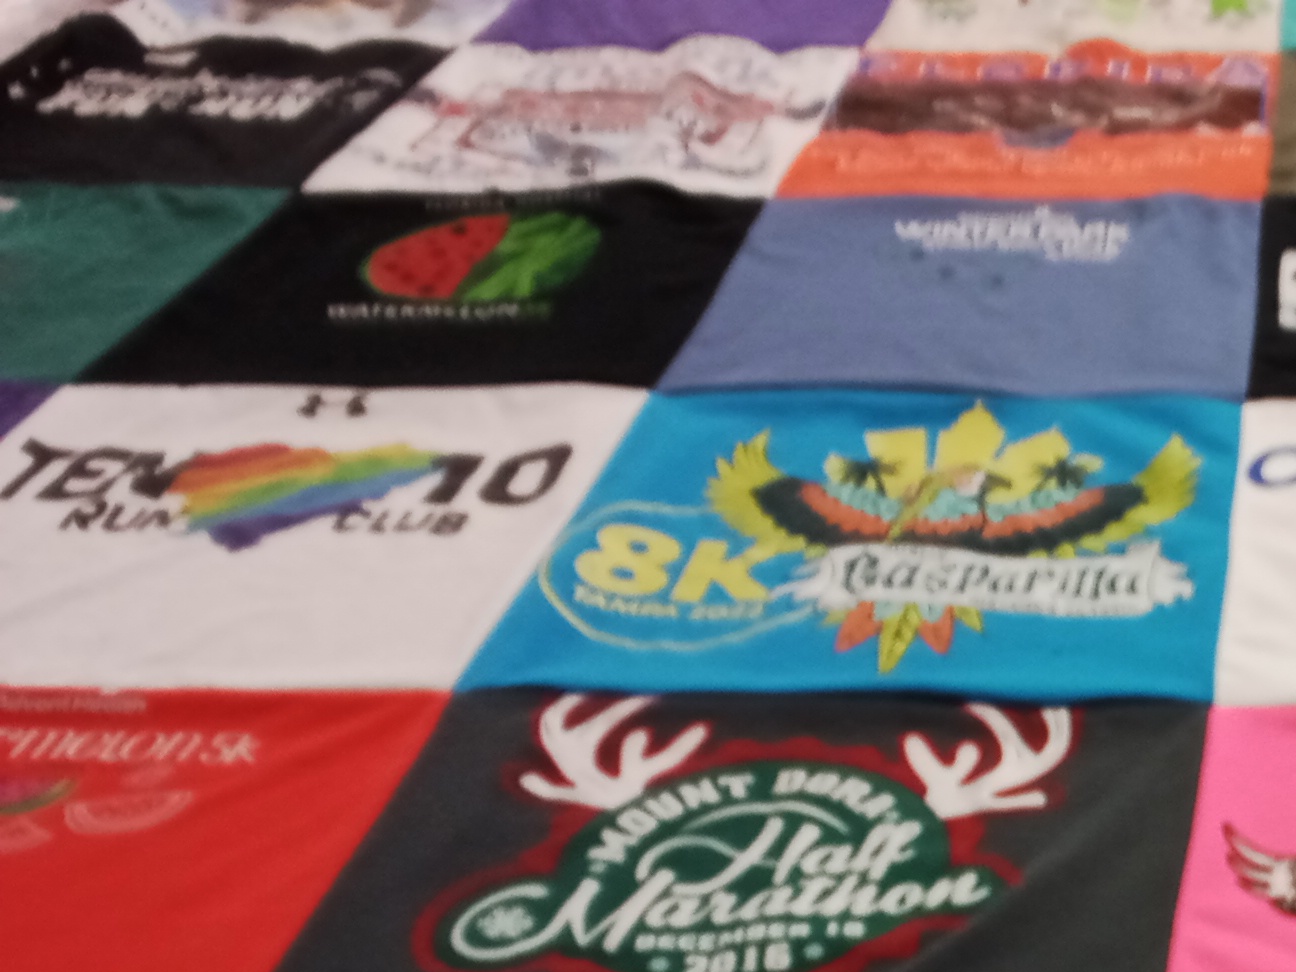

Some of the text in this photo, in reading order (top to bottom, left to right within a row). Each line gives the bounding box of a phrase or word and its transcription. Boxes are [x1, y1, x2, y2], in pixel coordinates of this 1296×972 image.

[1, 437, 573, 506] TEN 10
[59, 500, 470, 535] RUN CLUB
[573, 522, 775, 604] 8K
[586, 768, 897, 866] MOUNT DORA
[634, 815, 925, 898] Half
[451, 868, 994, 962] Marathon
